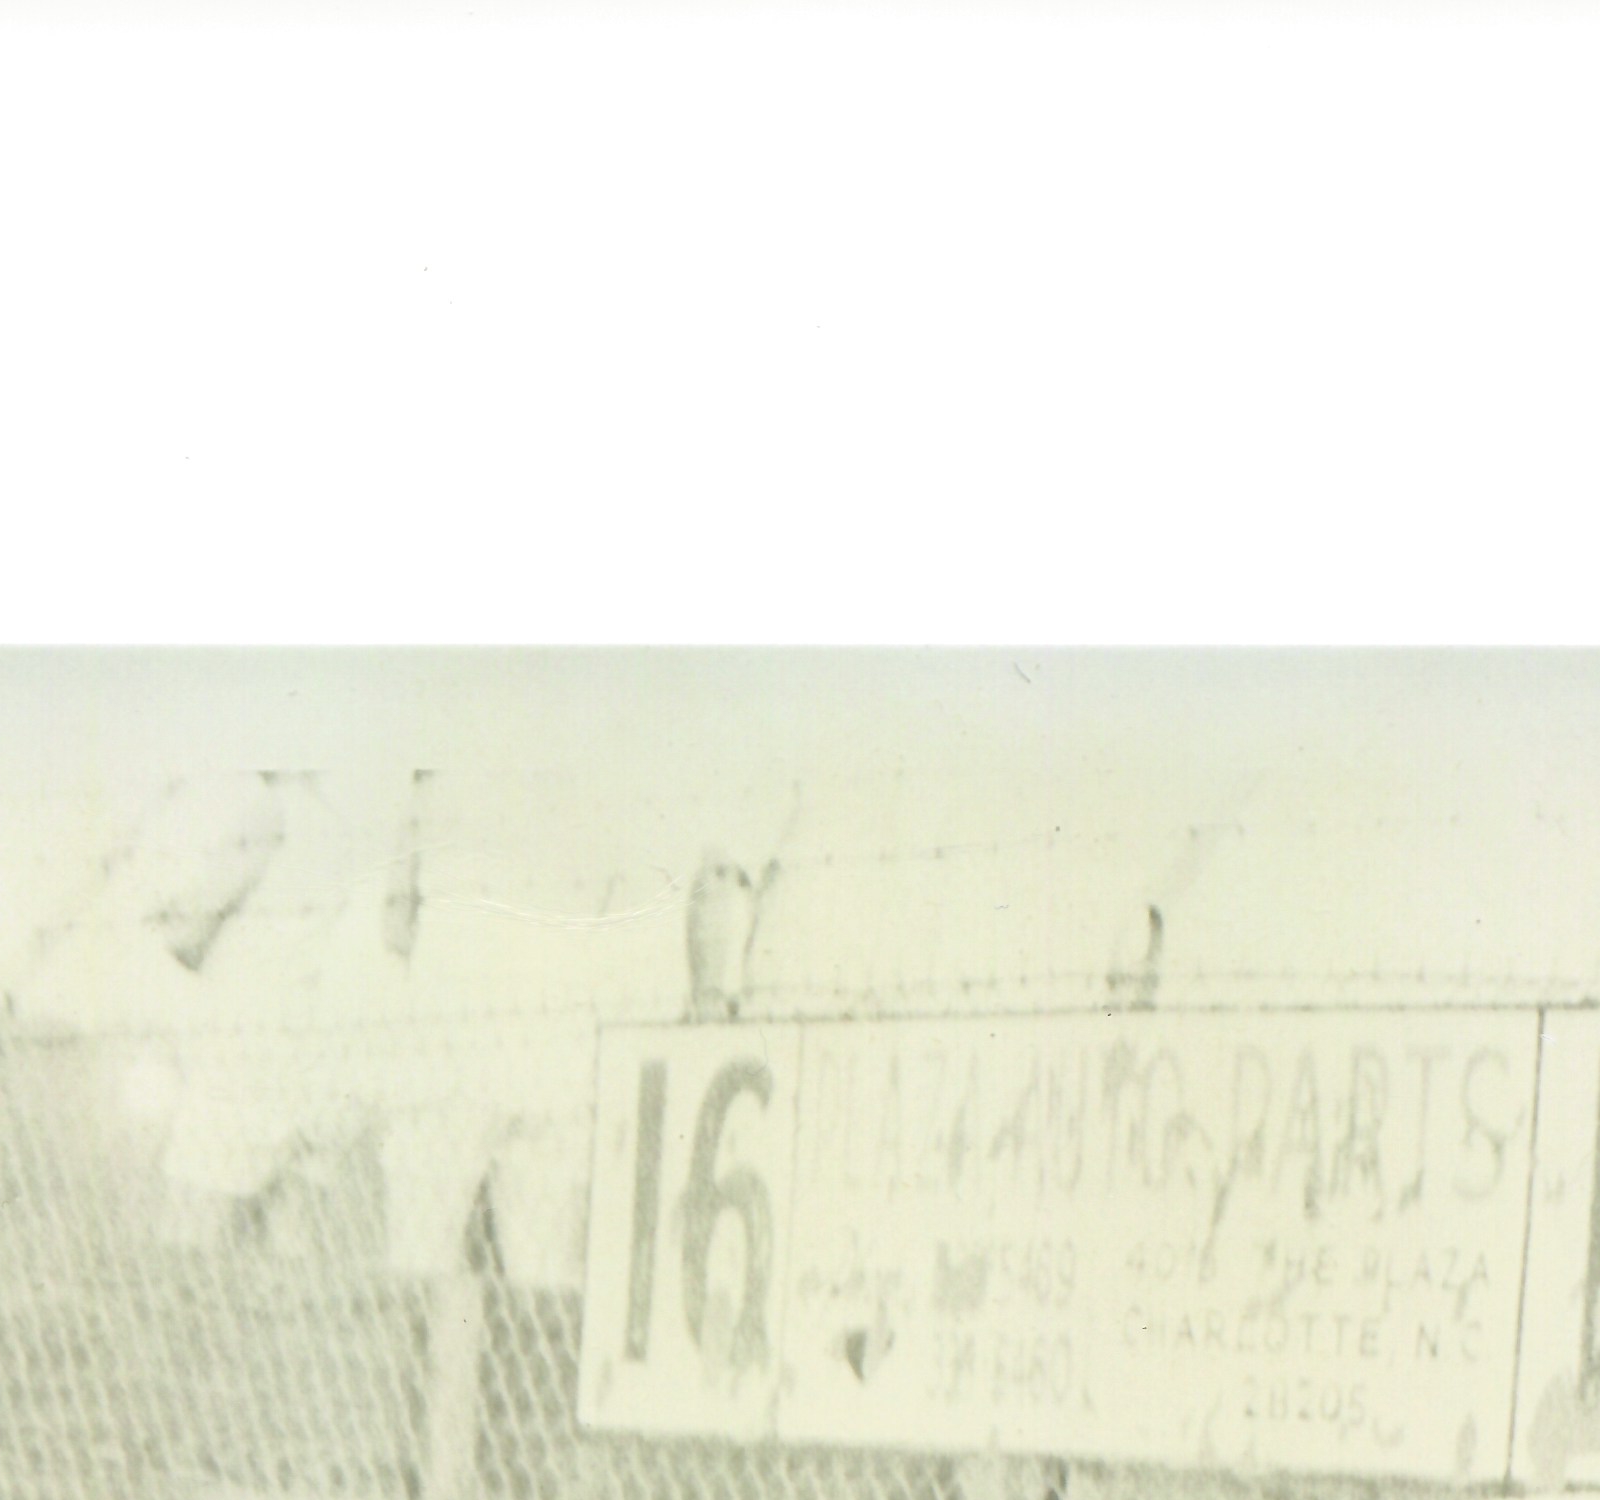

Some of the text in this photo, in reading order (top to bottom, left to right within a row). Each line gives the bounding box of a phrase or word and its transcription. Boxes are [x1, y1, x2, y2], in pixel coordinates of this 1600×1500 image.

[994, 1043, 1186, 1194] AUTO
[1230, 1042, 1513, 1203] PARTS
[622, 1054, 777, 1368] 16
[1253, 1238, 1339, 1288] THE
[1353, 1245, 1491, 1290] PLAZA
